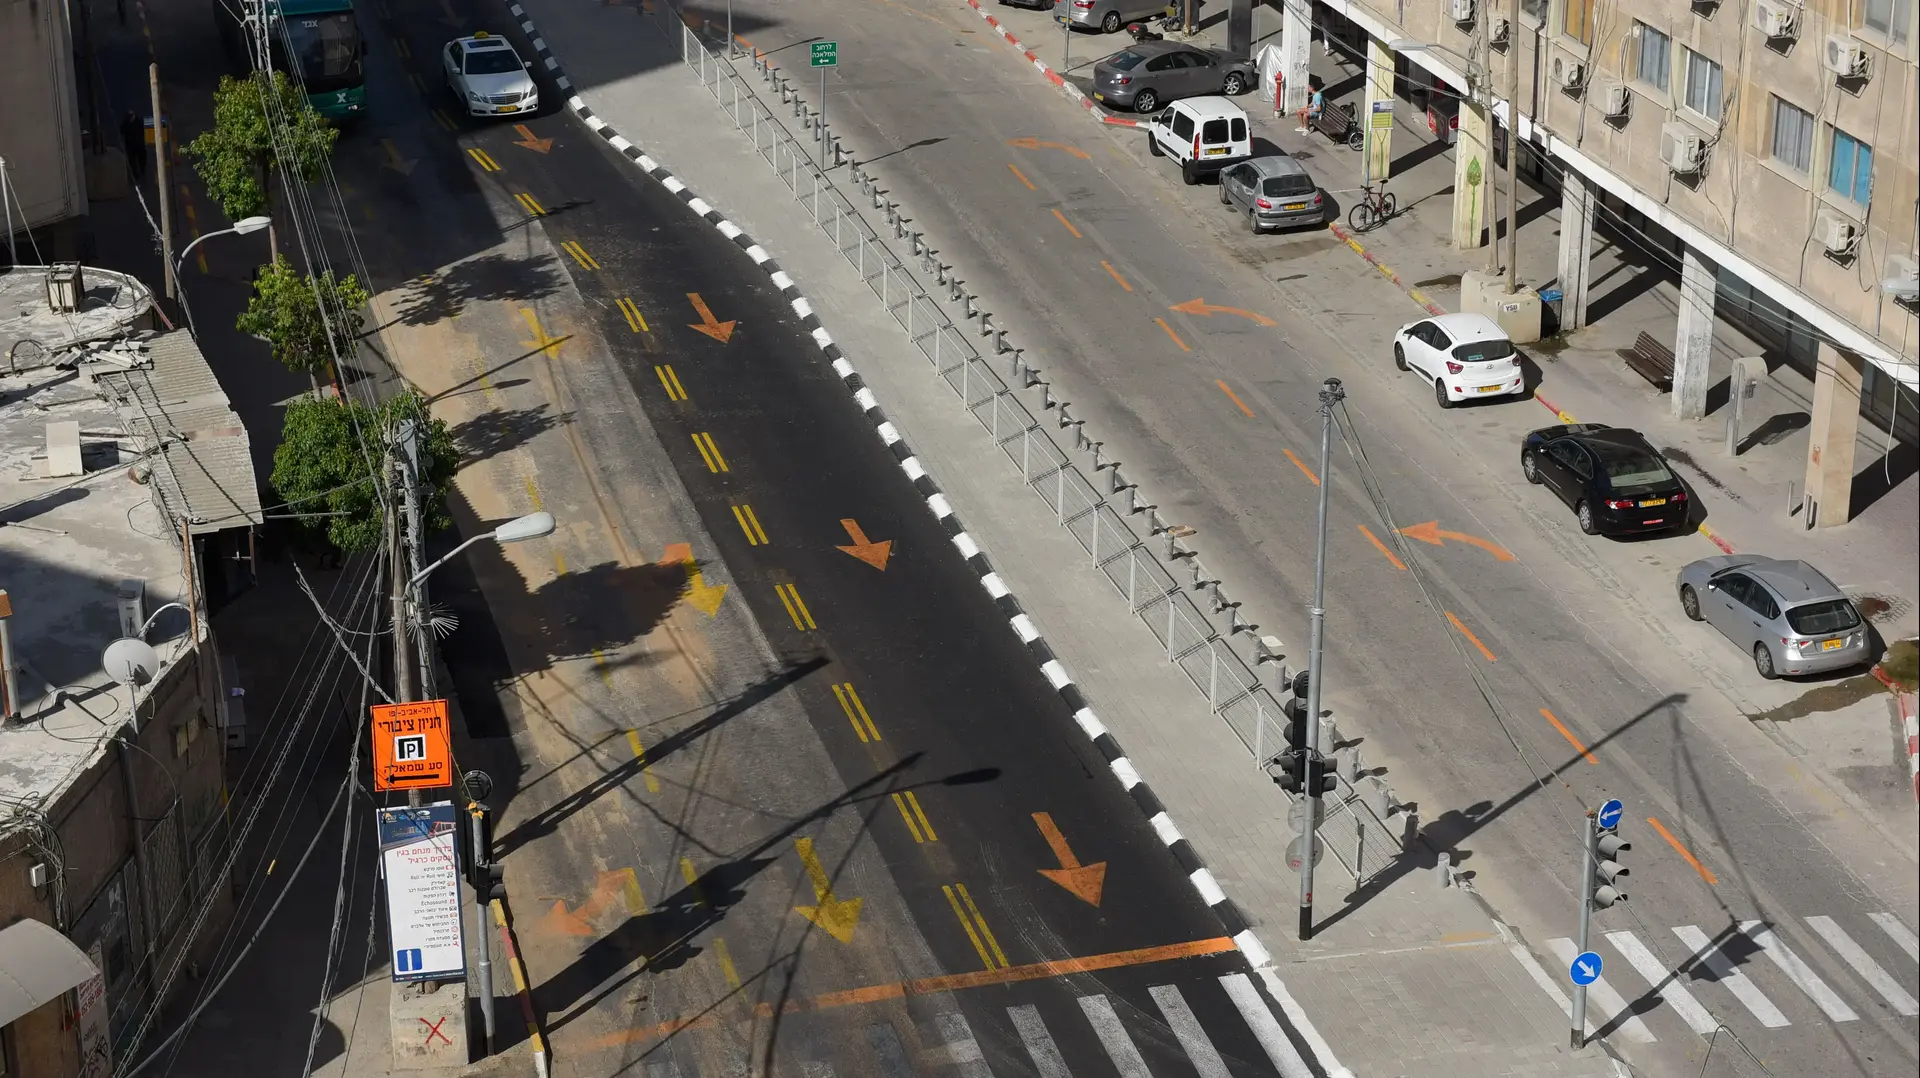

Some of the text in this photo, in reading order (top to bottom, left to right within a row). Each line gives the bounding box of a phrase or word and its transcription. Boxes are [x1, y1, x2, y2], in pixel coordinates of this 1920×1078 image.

[388, 706, 432, 717] תל-אביב-פו
[378, 716, 442, 733] חניון ציבורי
[406, 744, 416, 758] P
[384, 762, 443, 774] סע שמאלה
[430, 855, 452, 863] עסקים
